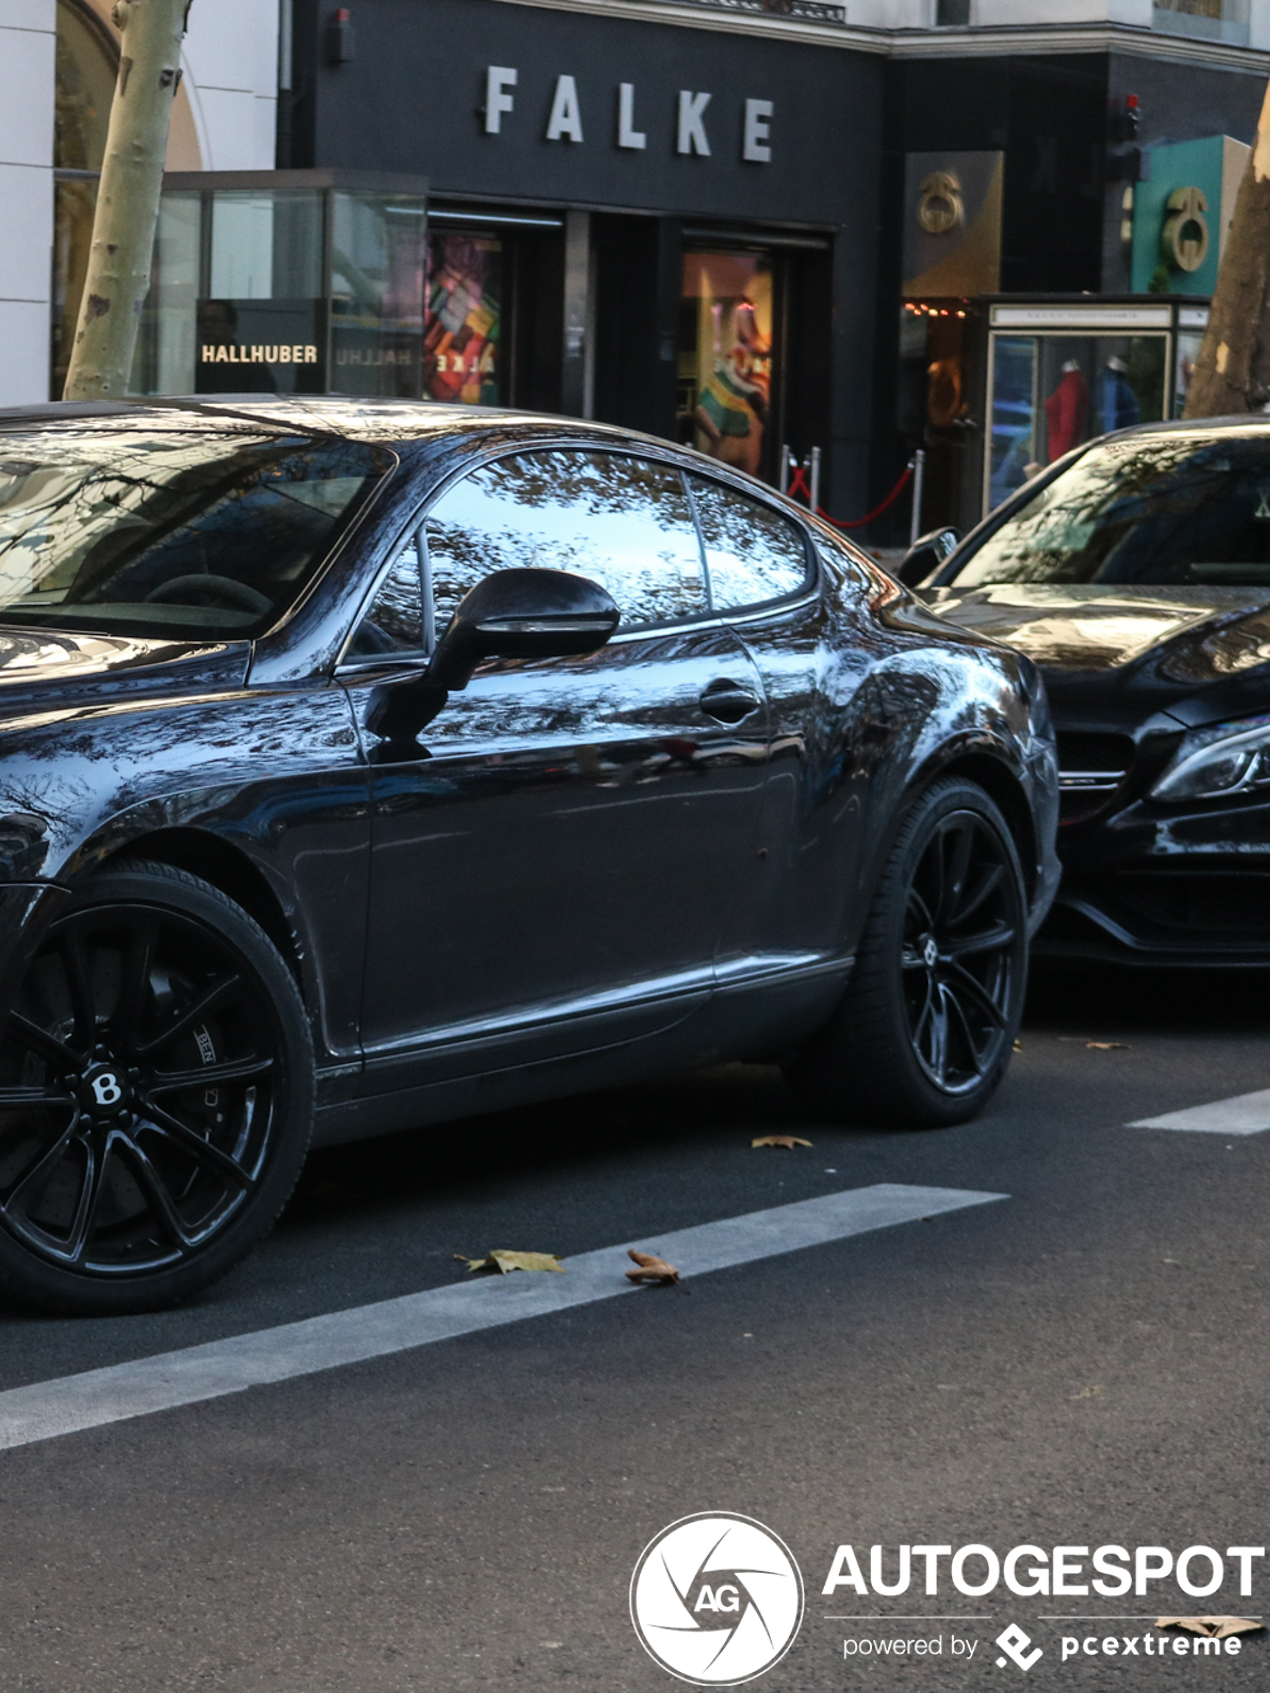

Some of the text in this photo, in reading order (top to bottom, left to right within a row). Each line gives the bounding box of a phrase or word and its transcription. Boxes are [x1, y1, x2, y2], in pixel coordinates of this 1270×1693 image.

[485, 65, 774, 162] FALKE
[201, 345, 317, 363] HALLHUBER
[91, 1073, 122, 1105] B
